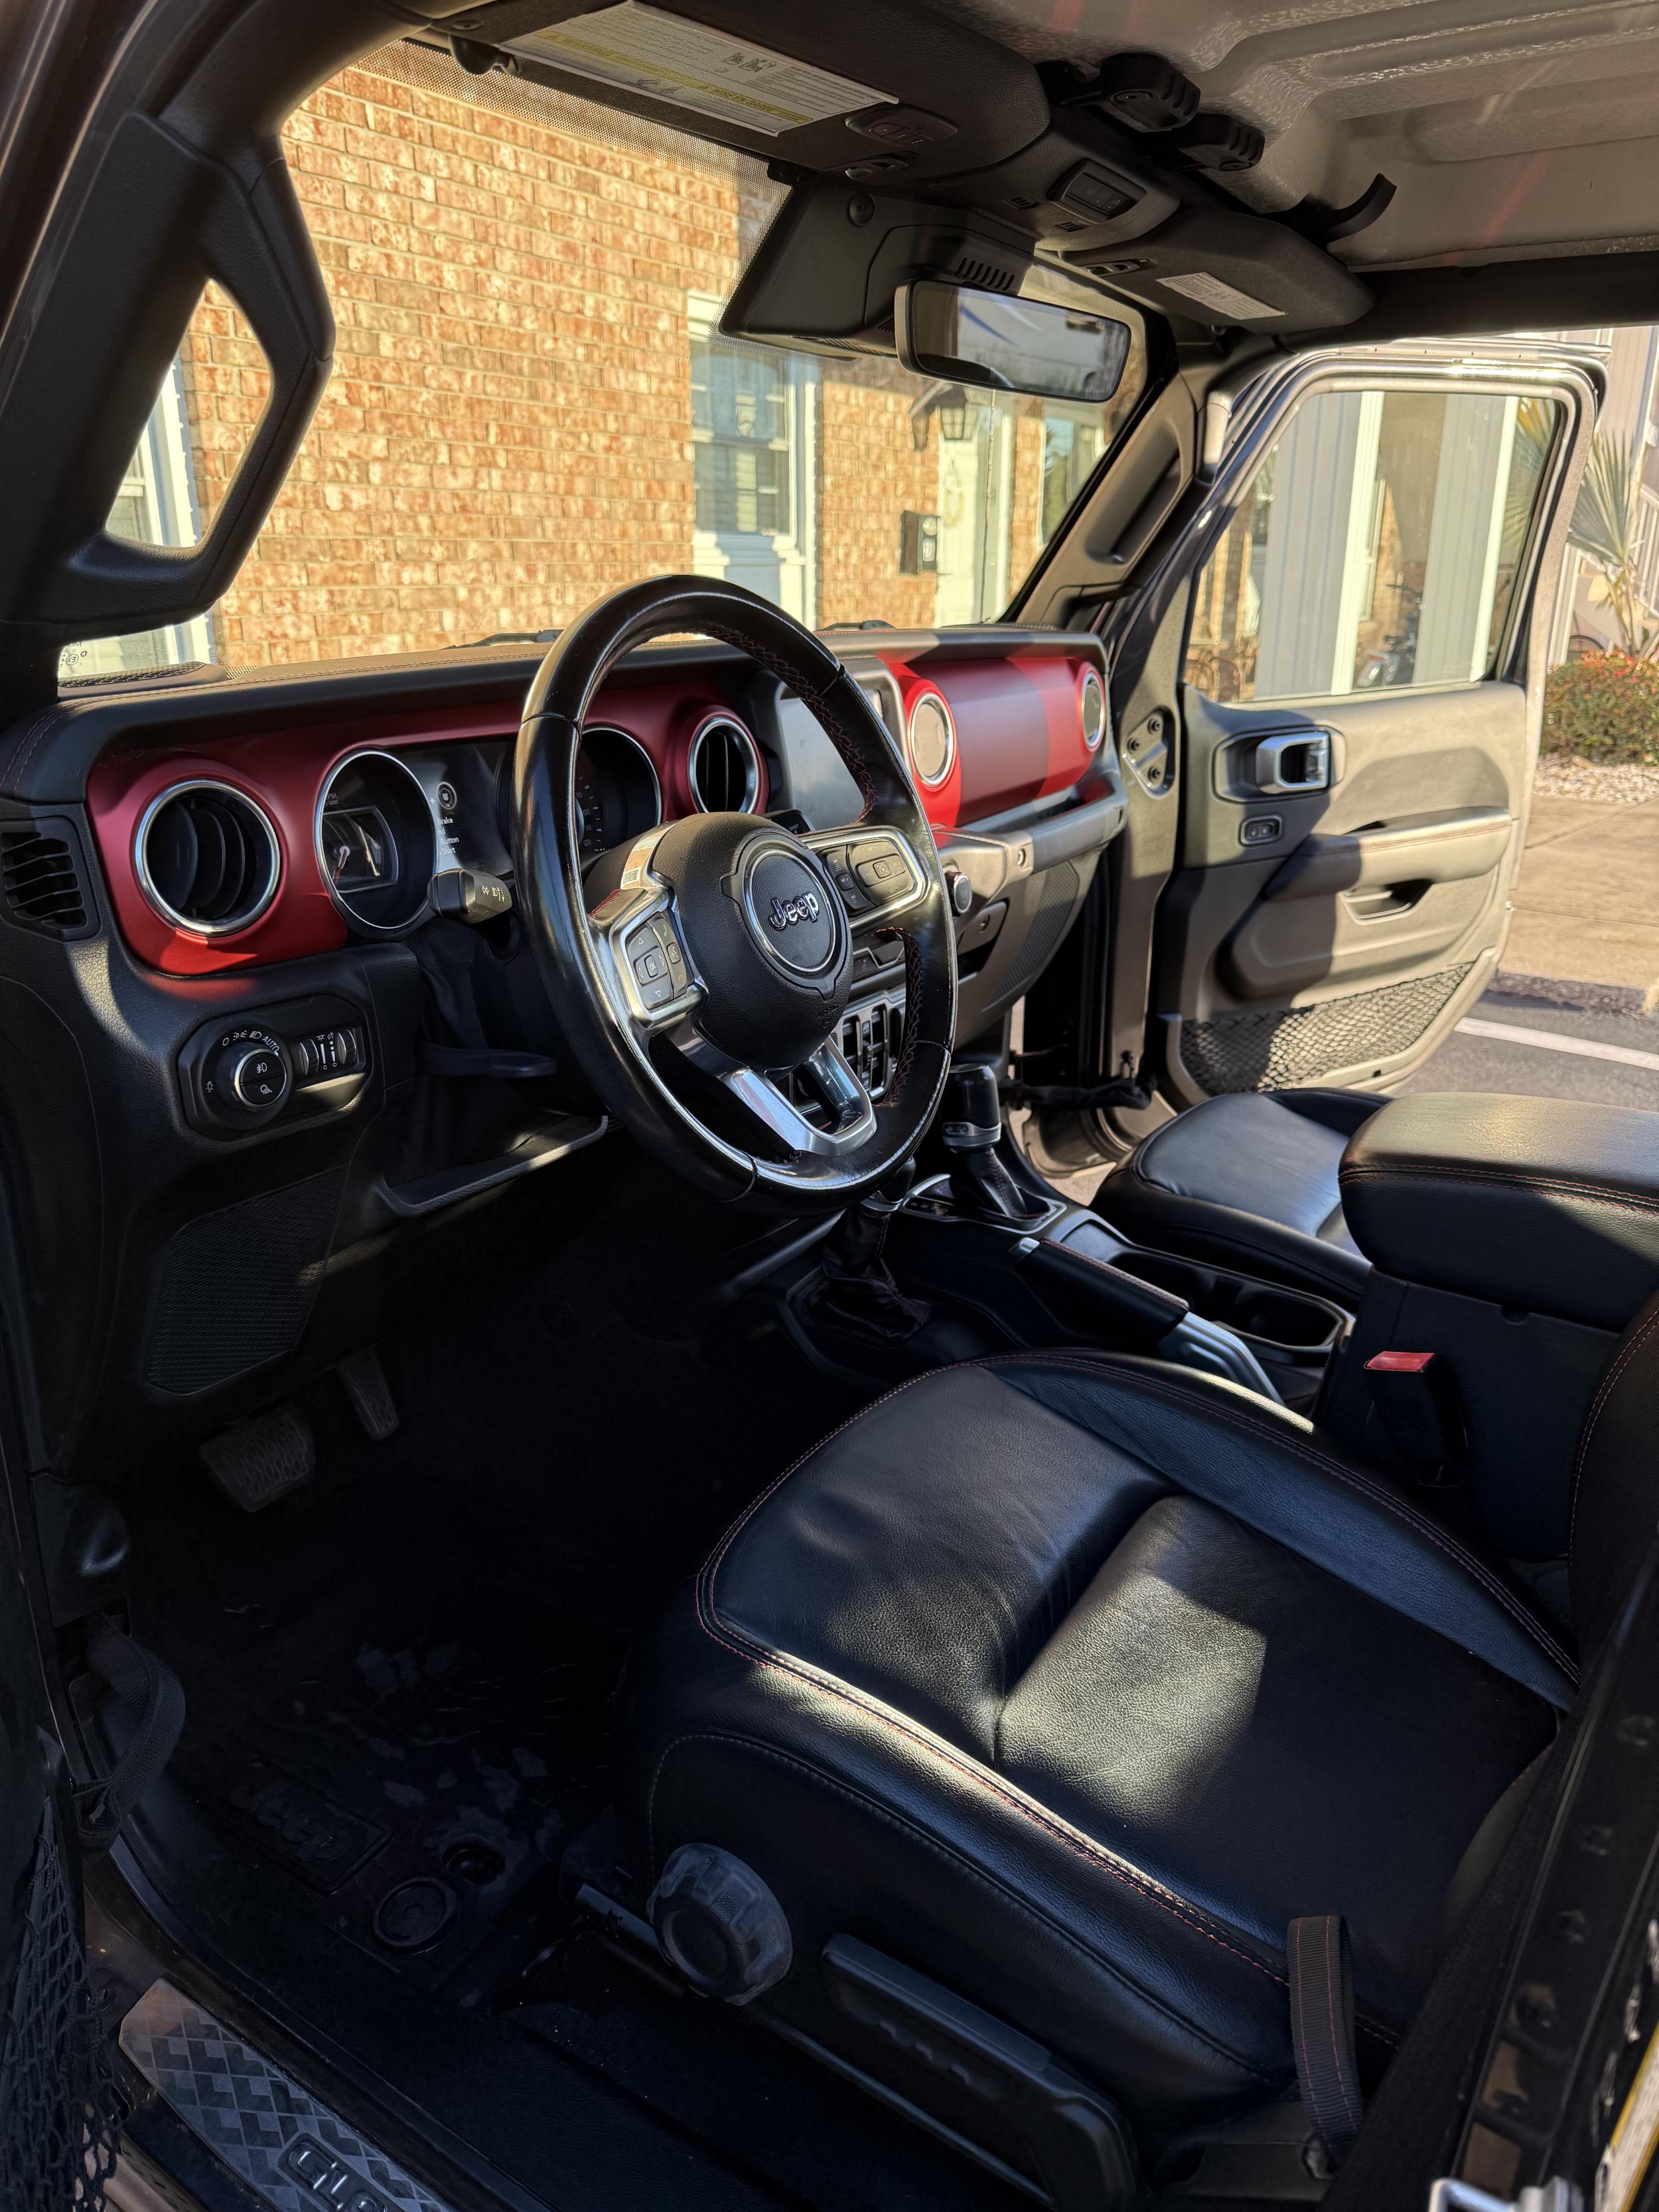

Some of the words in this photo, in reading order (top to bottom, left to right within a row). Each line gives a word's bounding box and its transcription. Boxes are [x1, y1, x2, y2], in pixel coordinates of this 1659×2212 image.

[437, 816, 454, 826] Brake
[441, 837, 459, 846] Button
[441, 847, 457, 855] Start
[768, 891, 820, 931] Jeep
[261, 1036, 279, 1052] AUTO
